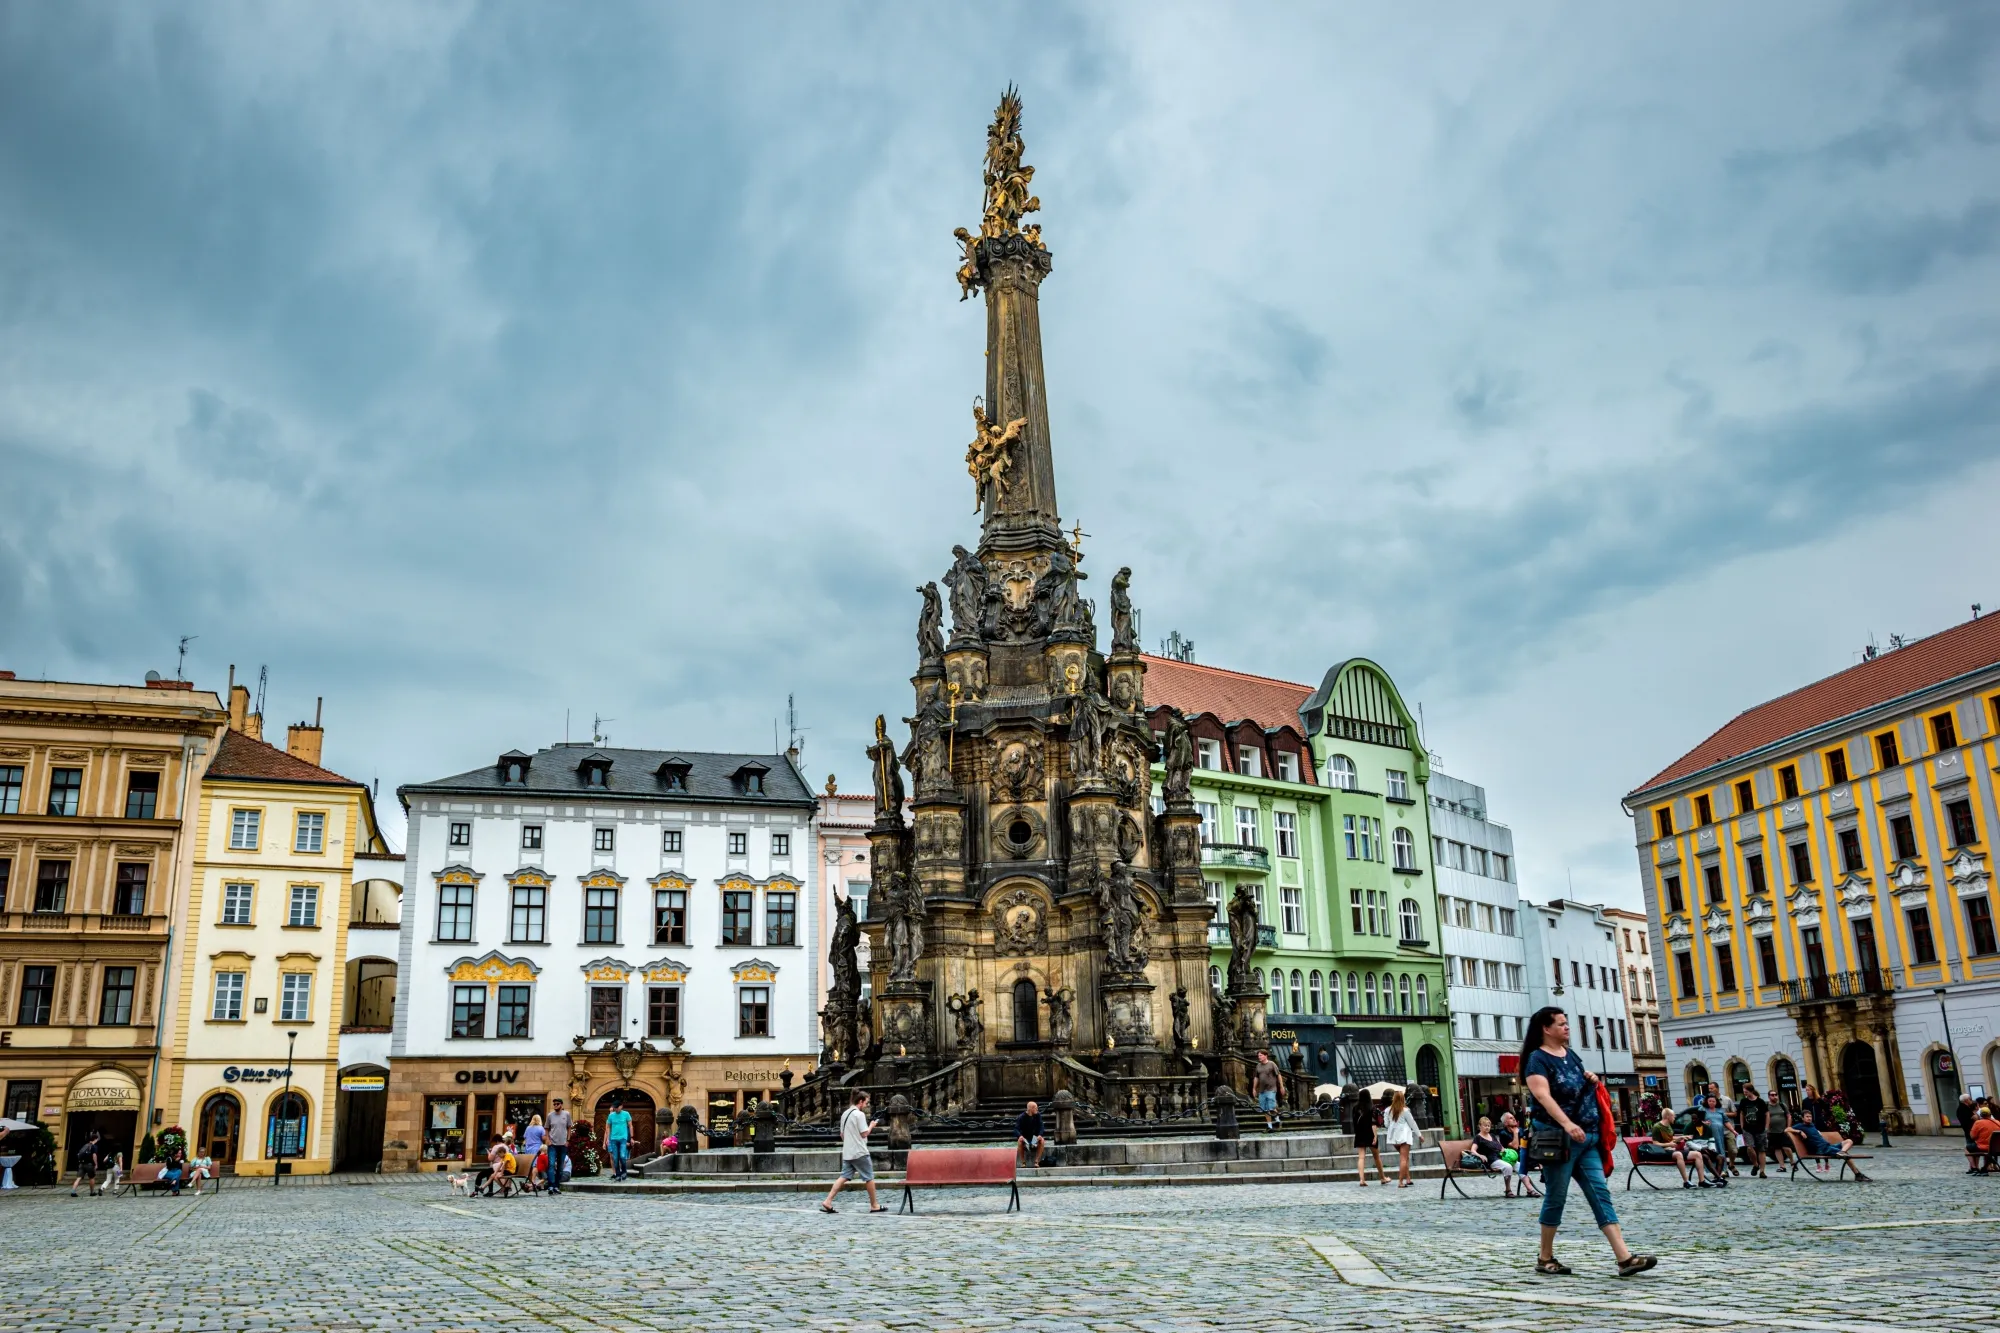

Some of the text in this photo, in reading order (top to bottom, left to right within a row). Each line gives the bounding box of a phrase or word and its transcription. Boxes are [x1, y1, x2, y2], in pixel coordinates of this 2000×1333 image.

[1271, 1029, 1297, 1039] POŠTA
[242, 1068, 293, 1079] Blue Style
[455, 1070, 520, 1083] OBUV
[725, 1070, 780, 1081] Pekařstv
[74, 1099, 125, 1107] RESTAURACE
